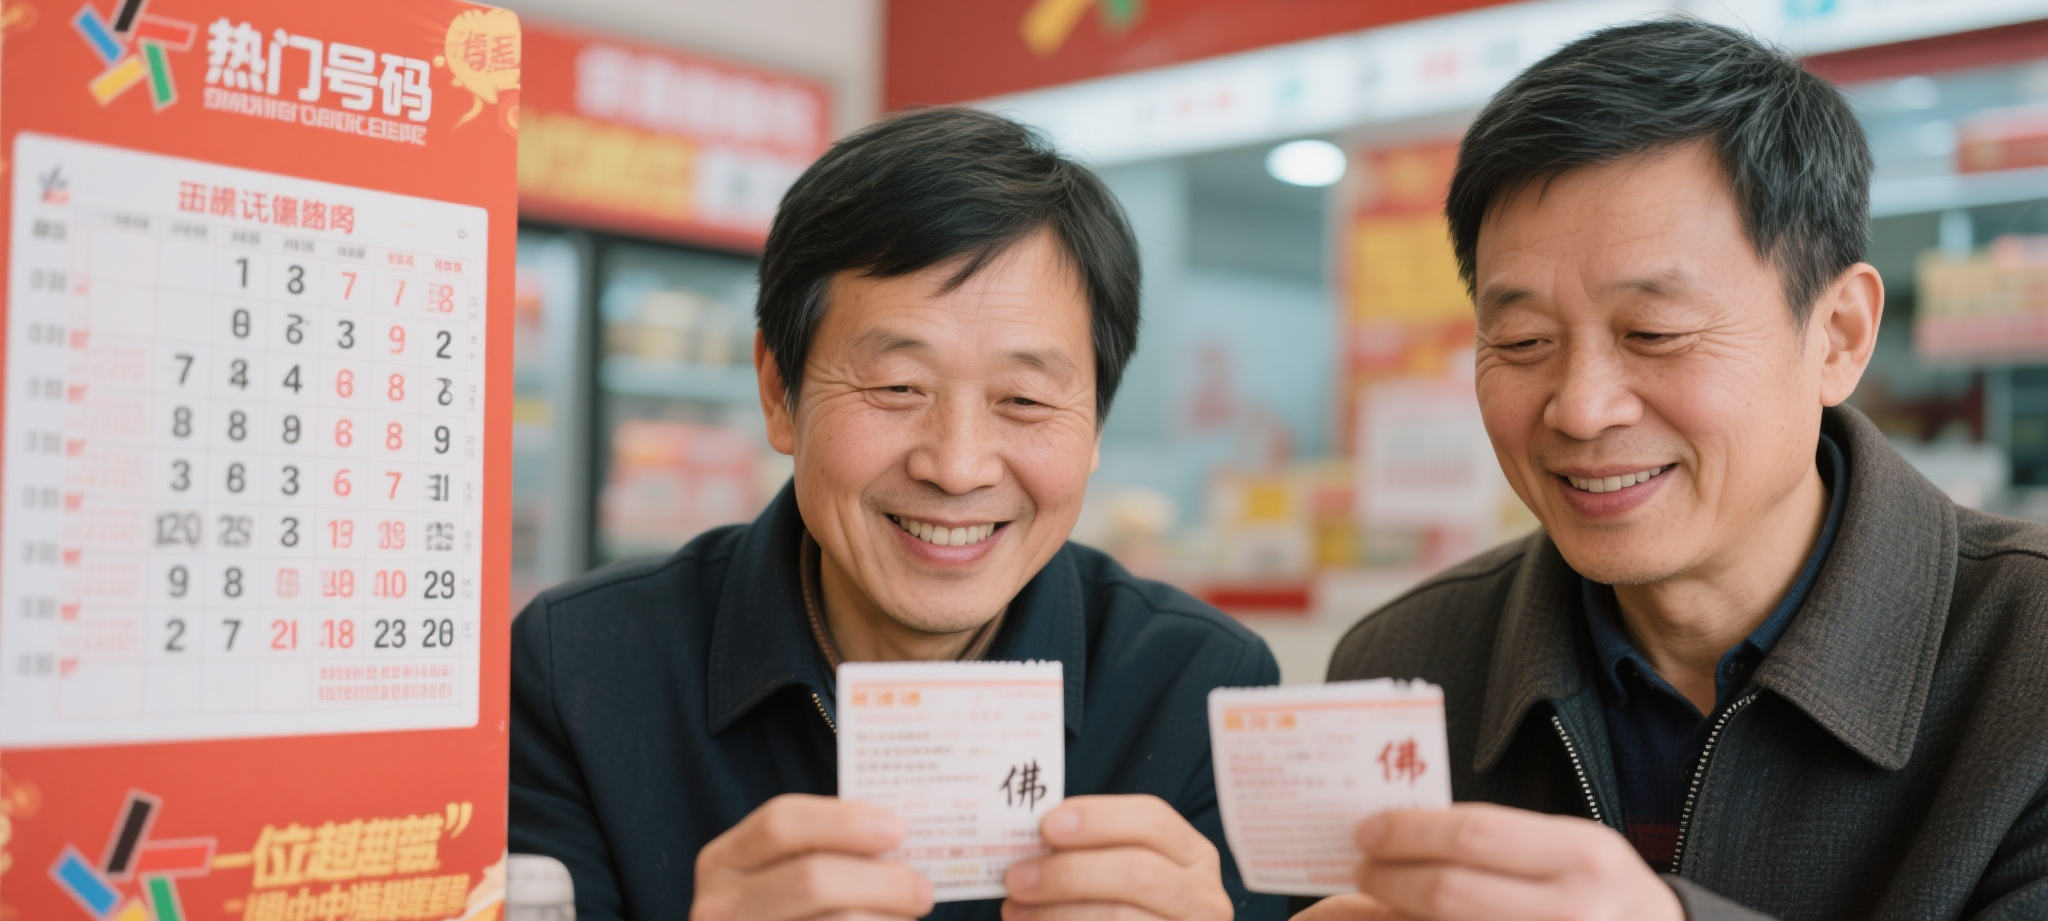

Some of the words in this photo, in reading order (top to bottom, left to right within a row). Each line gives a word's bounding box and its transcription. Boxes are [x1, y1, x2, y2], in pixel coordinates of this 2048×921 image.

[206, 18, 432, 122] 热门号码
[236, 258, 249, 288] 1
[342, 272, 357, 299] 7
[337, 320, 355, 349] 3
[389, 325, 406, 354] 9
[436, 330, 452, 359] 2
[175, 353, 194, 385] 7
[282, 364, 303, 394] 4
[172, 406, 193, 439] 8
[227, 410, 248, 442] 8
[434, 425, 450, 454] 9
[171, 459, 191, 492] 3
[281, 465, 300, 496] 3
[334, 468, 351, 497] 6
[385, 471, 402, 500] 7
[168, 565, 189, 598] 9
[223, 566, 243, 599] 8
[424, 570, 455, 600] 29
[165, 618, 186, 652] 2
[222, 619, 242, 651] 7
[271, 619, 297, 650] 21
[374, 619, 406, 648] 23
[1377, 737, 1426, 786] 佛
[1000, 760, 1046, 811] 佛
